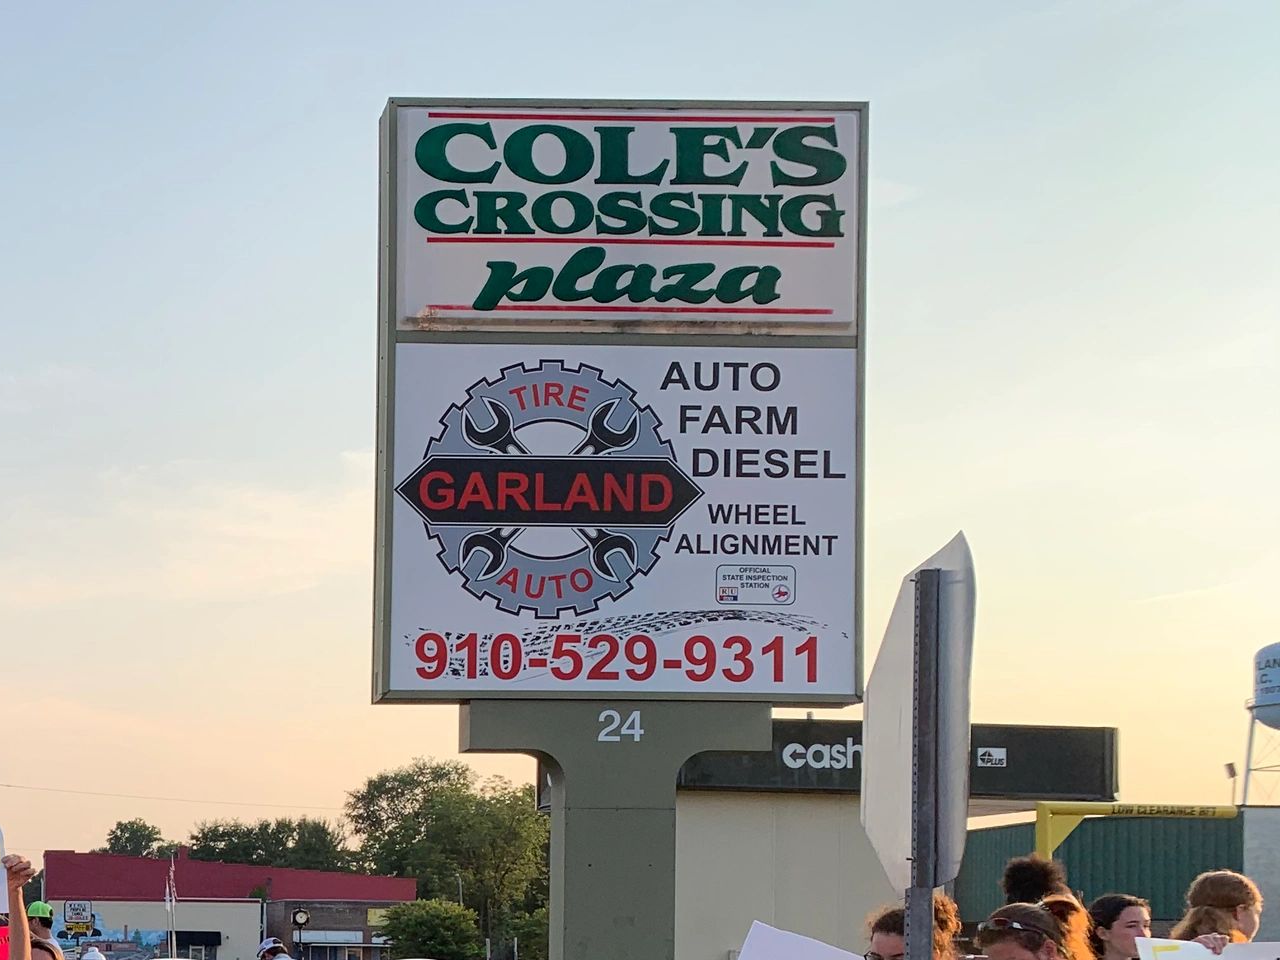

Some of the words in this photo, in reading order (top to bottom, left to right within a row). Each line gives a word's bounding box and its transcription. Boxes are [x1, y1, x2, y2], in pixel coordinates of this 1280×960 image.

[414, 121, 848, 188] COLE'S
[413, 188, 846, 238] CROSSING
[471, 245, 782, 312] plaza
[658, 361, 782, 392] AUTO
[508, 381, 590, 413] TIRE
[679, 404, 799, 436] FARM
[691, 447, 847, 480] DIESEL
[419, 469, 674, 513] GARLAND
[707, 503, 807, 526] WHEEL
[673, 533, 840, 556] ALIGNMENT
[496, 566, 594, 600] AUTO
[745, 574, 789, 582] INSPECTION
[414, 631, 819, 684] 910-529-9311
[597, 709, 644, 743] 24
[985, 757, 1006, 766] PLUS
[1111, 805, 1134, 815] LOW
[1136, 805, 1196, 816] CLEARANCE
